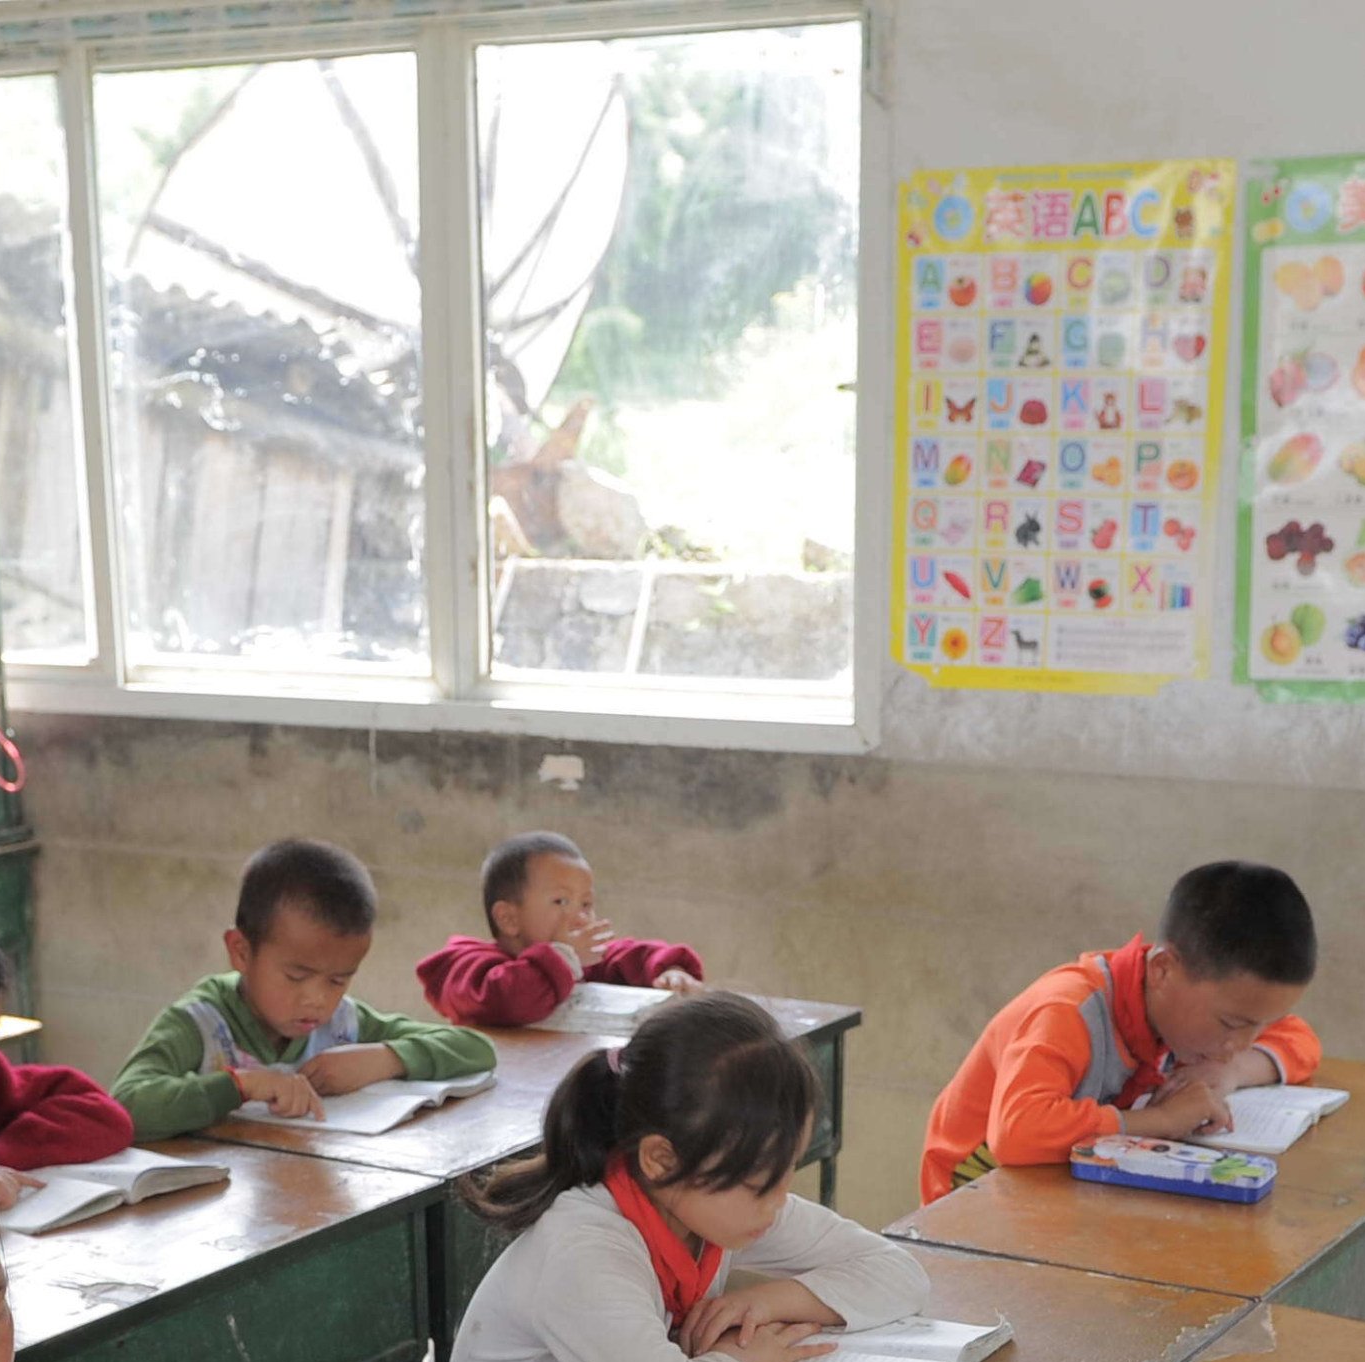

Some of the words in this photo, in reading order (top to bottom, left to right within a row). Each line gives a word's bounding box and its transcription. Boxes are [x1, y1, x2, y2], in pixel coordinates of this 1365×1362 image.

[921, 261, 937, 288] A
[992, 260, 1017, 291] B
[1067, 258, 1094, 289] C
[1146, 255, 1170, 288] D
[918, 320, 940, 352] E
[990, 320, 1015, 351] F
[1065, 319, 1086, 348] G
[989, 384, 1014, 412] J
[1063, 383, 1086, 412] K
[1139, 384, 1162, 411] L
[914, 443, 939, 470] M
[1061, 442, 1085, 471] O
[1137, 443, 1160, 471] P
[986, 502, 1009, 531] R
[1058, 503, 1082, 532] S
[1136, 504, 1156, 533] T
[911, 559, 935, 588] U
[985, 560, 1006, 589] V
[1055, 564, 1080, 589] W
[1132, 566, 1153, 593] X
[914, 617, 932, 643] Y
[982, 618, 1006, 647] Z
